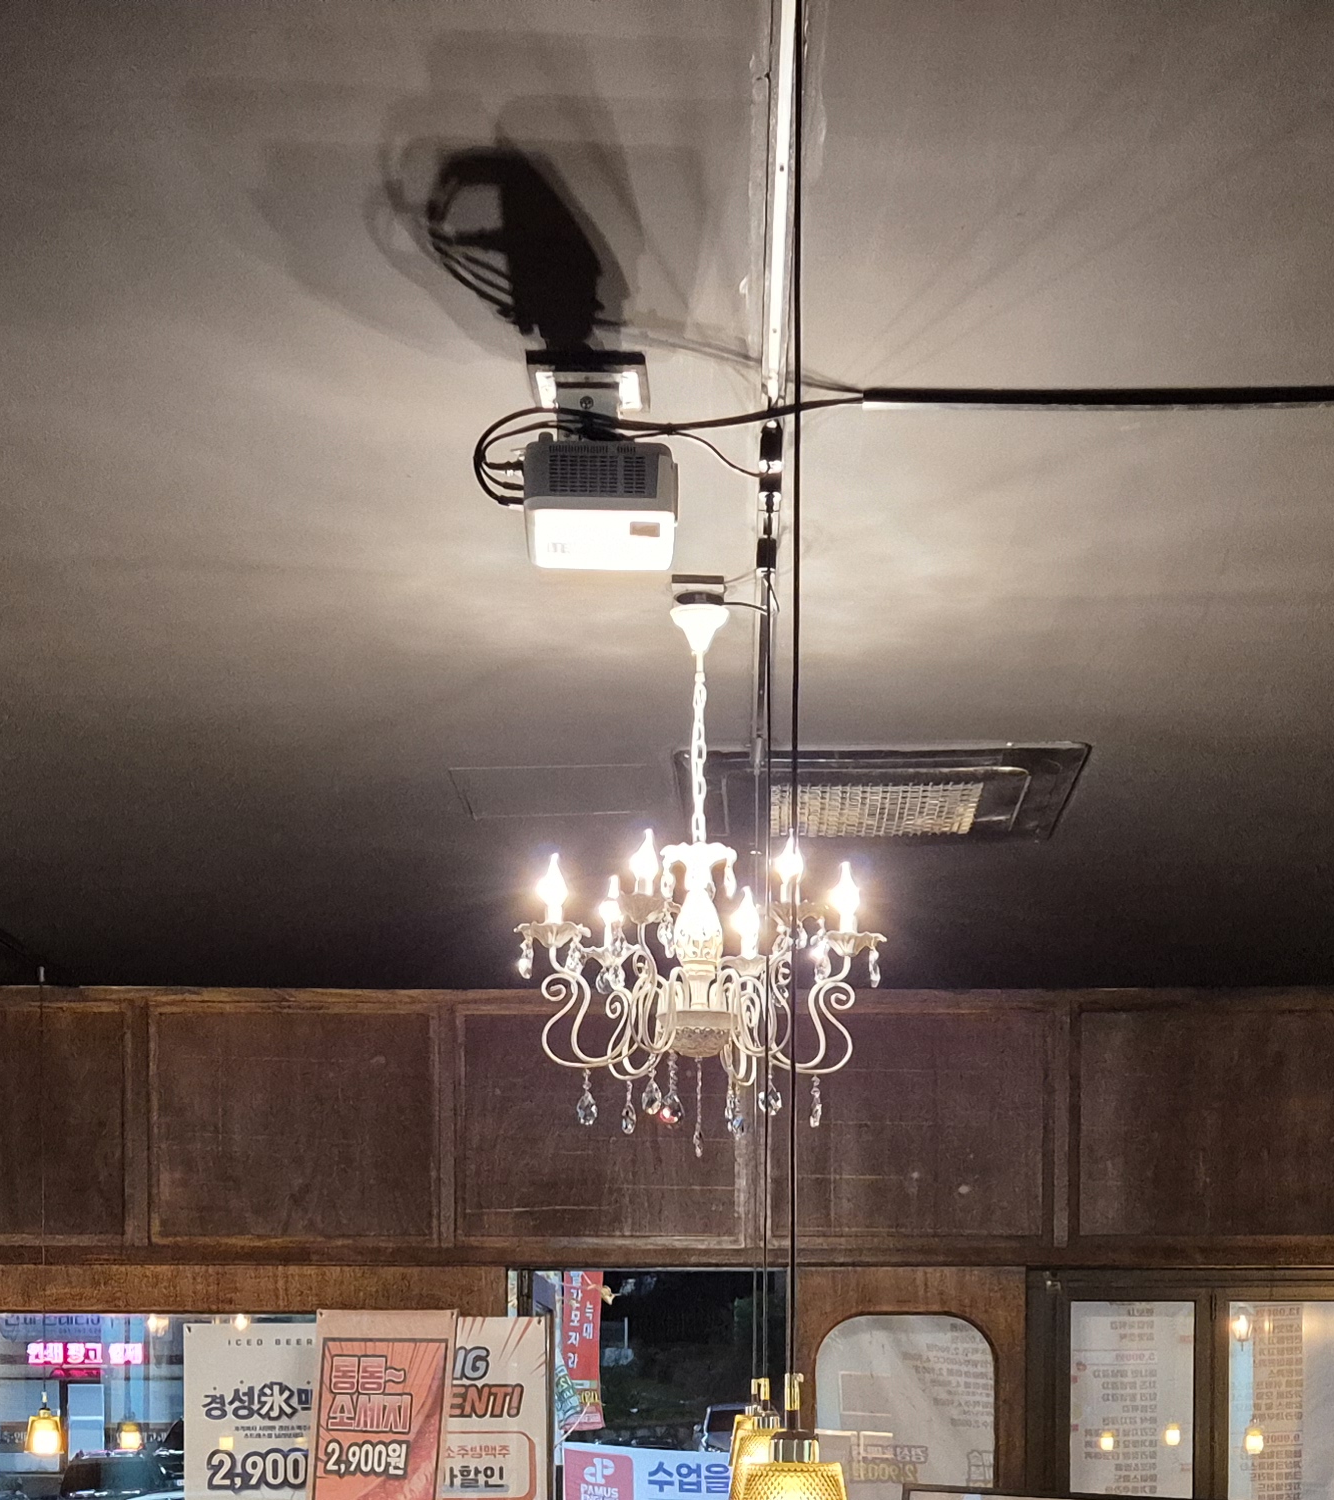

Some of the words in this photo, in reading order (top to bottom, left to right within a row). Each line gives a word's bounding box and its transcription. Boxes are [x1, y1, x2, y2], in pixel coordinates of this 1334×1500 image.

[228, 1338, 263, 1347] ICED
[274, 1338, 313, 1347] BEER
[327, 1393, 413, 1434] 소세지
[324, 1440, 409, 1477] 2,900원
[580, 1483, 619, 1499] PAMUS
[647, 1461, 731, 1494] 수업을
